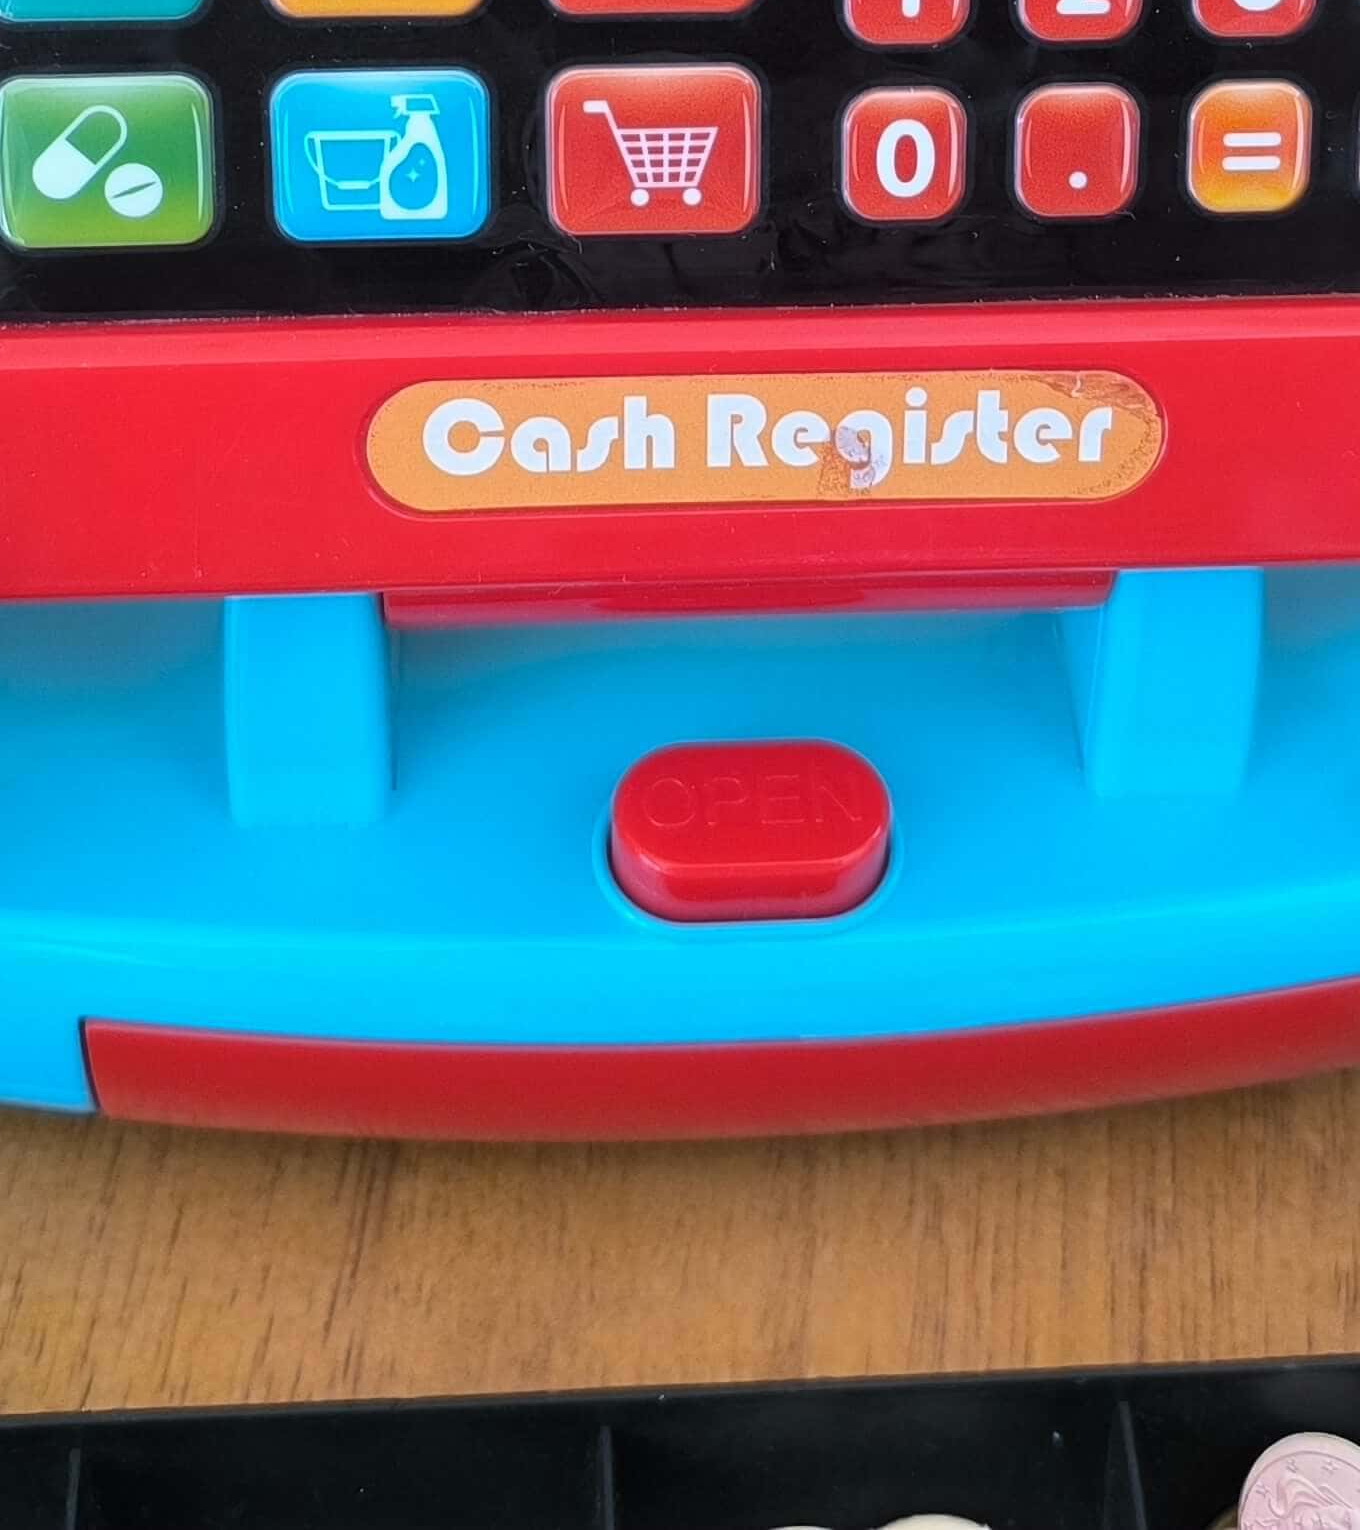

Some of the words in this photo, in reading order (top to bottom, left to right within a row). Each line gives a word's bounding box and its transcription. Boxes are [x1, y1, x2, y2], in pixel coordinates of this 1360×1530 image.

[875, 118, 936, 198] 0
[421, 393, 676, 477] Cash
[705, 386, 1114, 490] Register
[643, 772, 863, 828] OPEN
